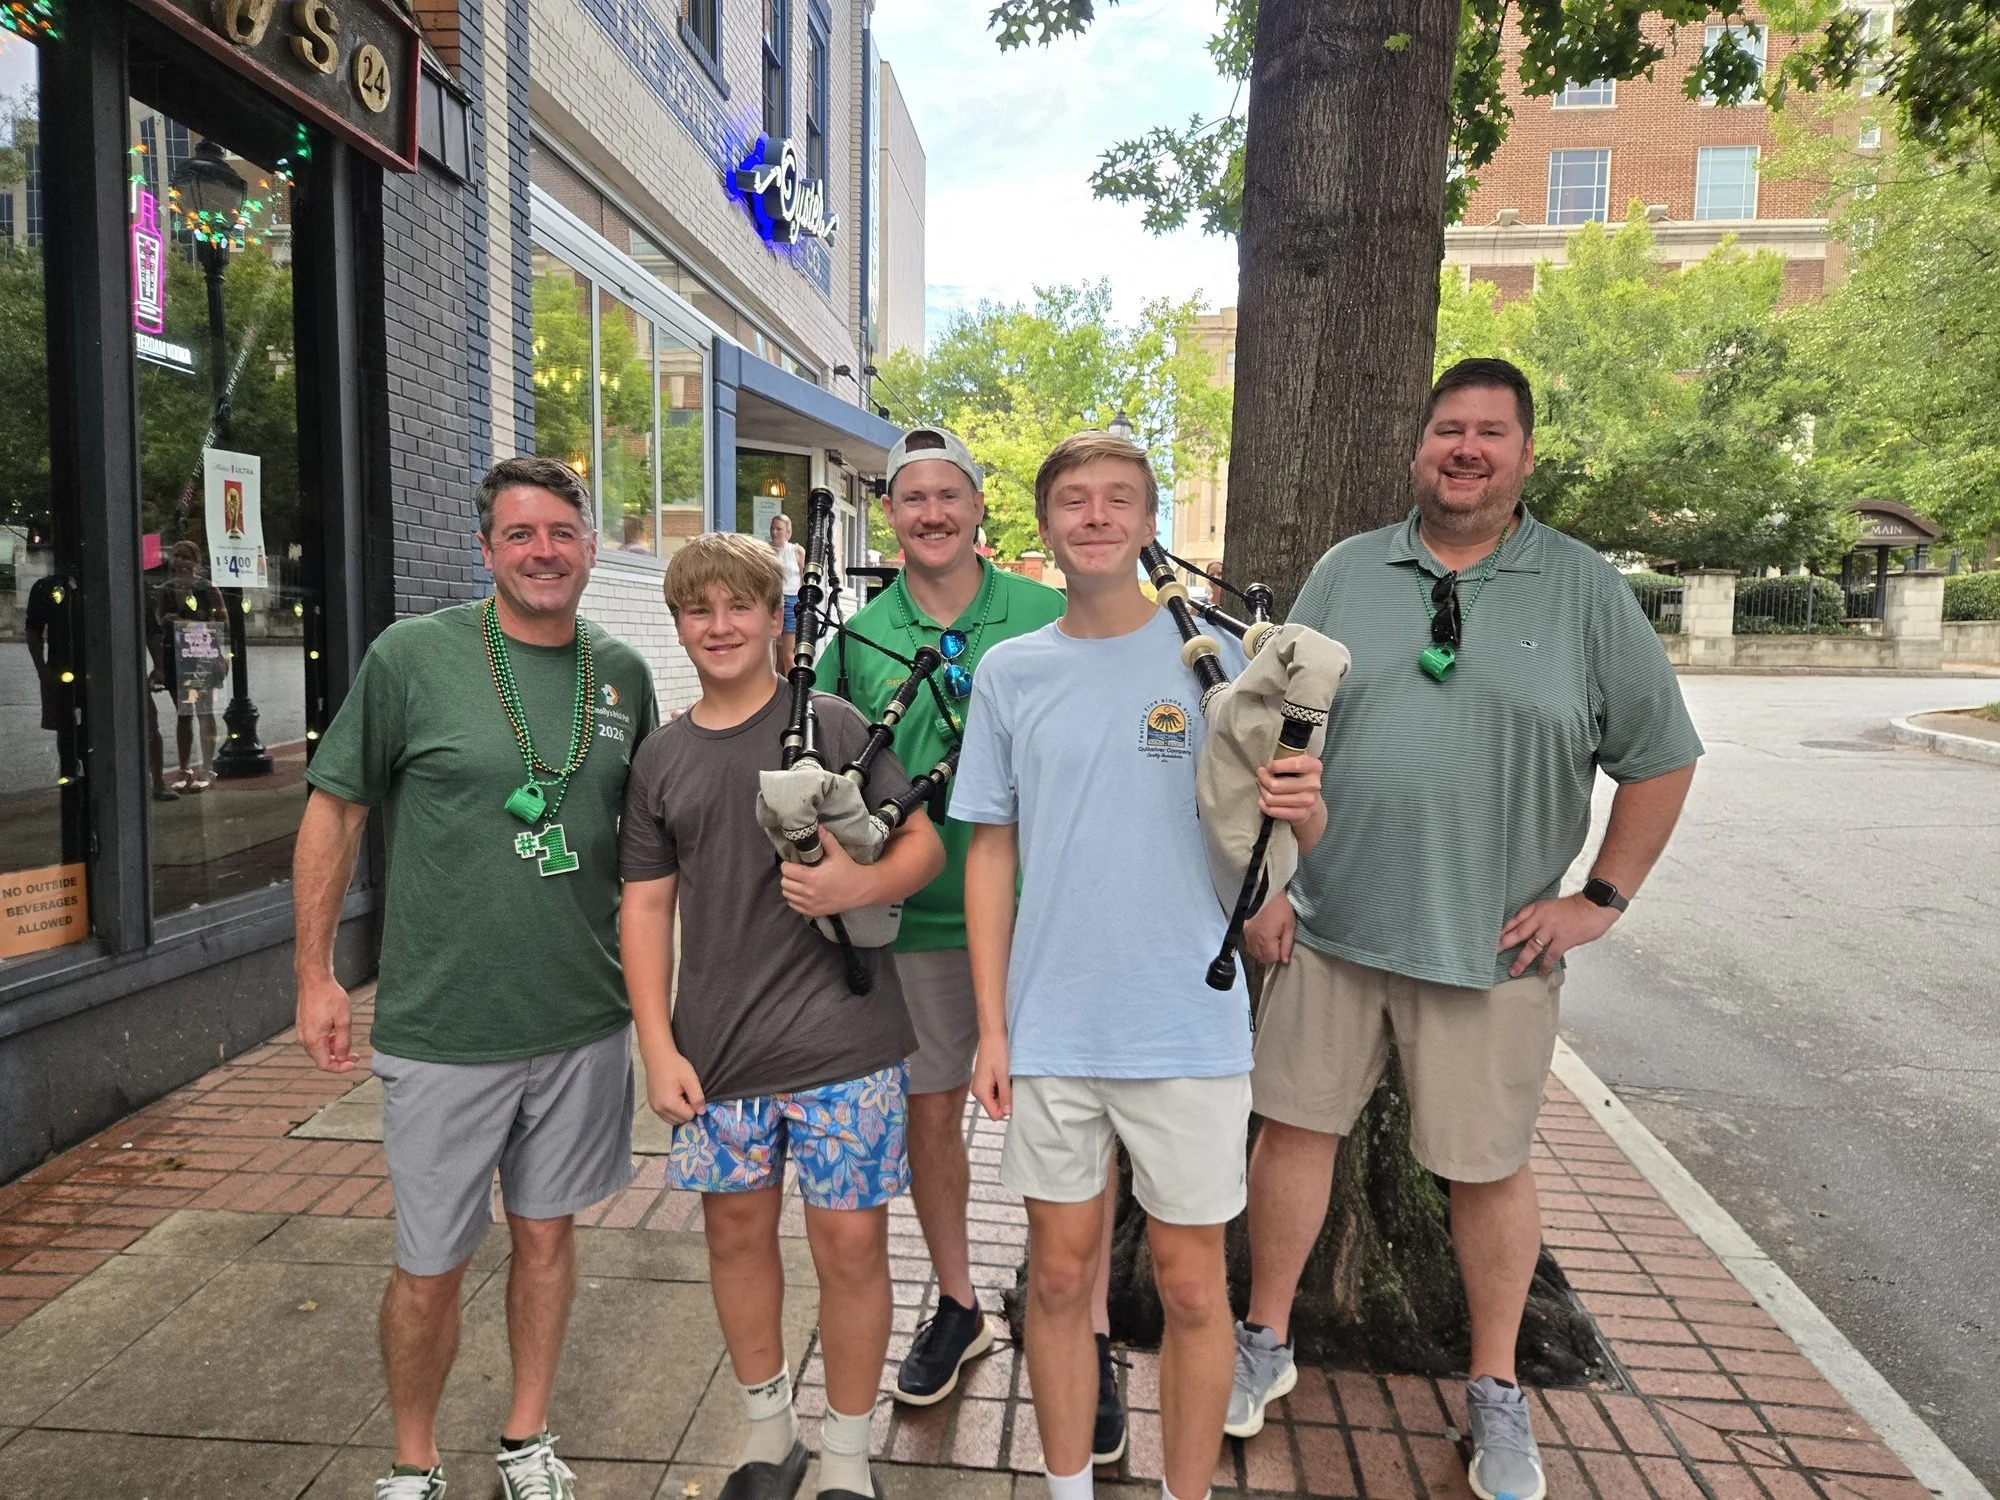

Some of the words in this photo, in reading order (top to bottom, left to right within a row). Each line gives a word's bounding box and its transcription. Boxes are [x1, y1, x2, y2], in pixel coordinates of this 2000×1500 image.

[362, 55, 387, 101] 24
[755, 138, 839, 246] Oyster
[191, 427, 216, 480] WHINEY
[224, 371, 240, 396] TAKE
[234, 347, 248, 373] YOUR
[1871, 525, 1903, 535] MAIN
[1144, 700, 1158, 711] fine
[1161, 698, 1182, 706] since
[598, 723, 625, 742] 2026
[1166, 747, 1192, 756] Company
[514, 823, 580, 877] #1
[2, 886, 22, 899] NO
[26, 876, 78, 895] OUTSIDE
[6, 895, 79, 918] BEVERAGES
[17, 915, 73, 936] ALLOWED
